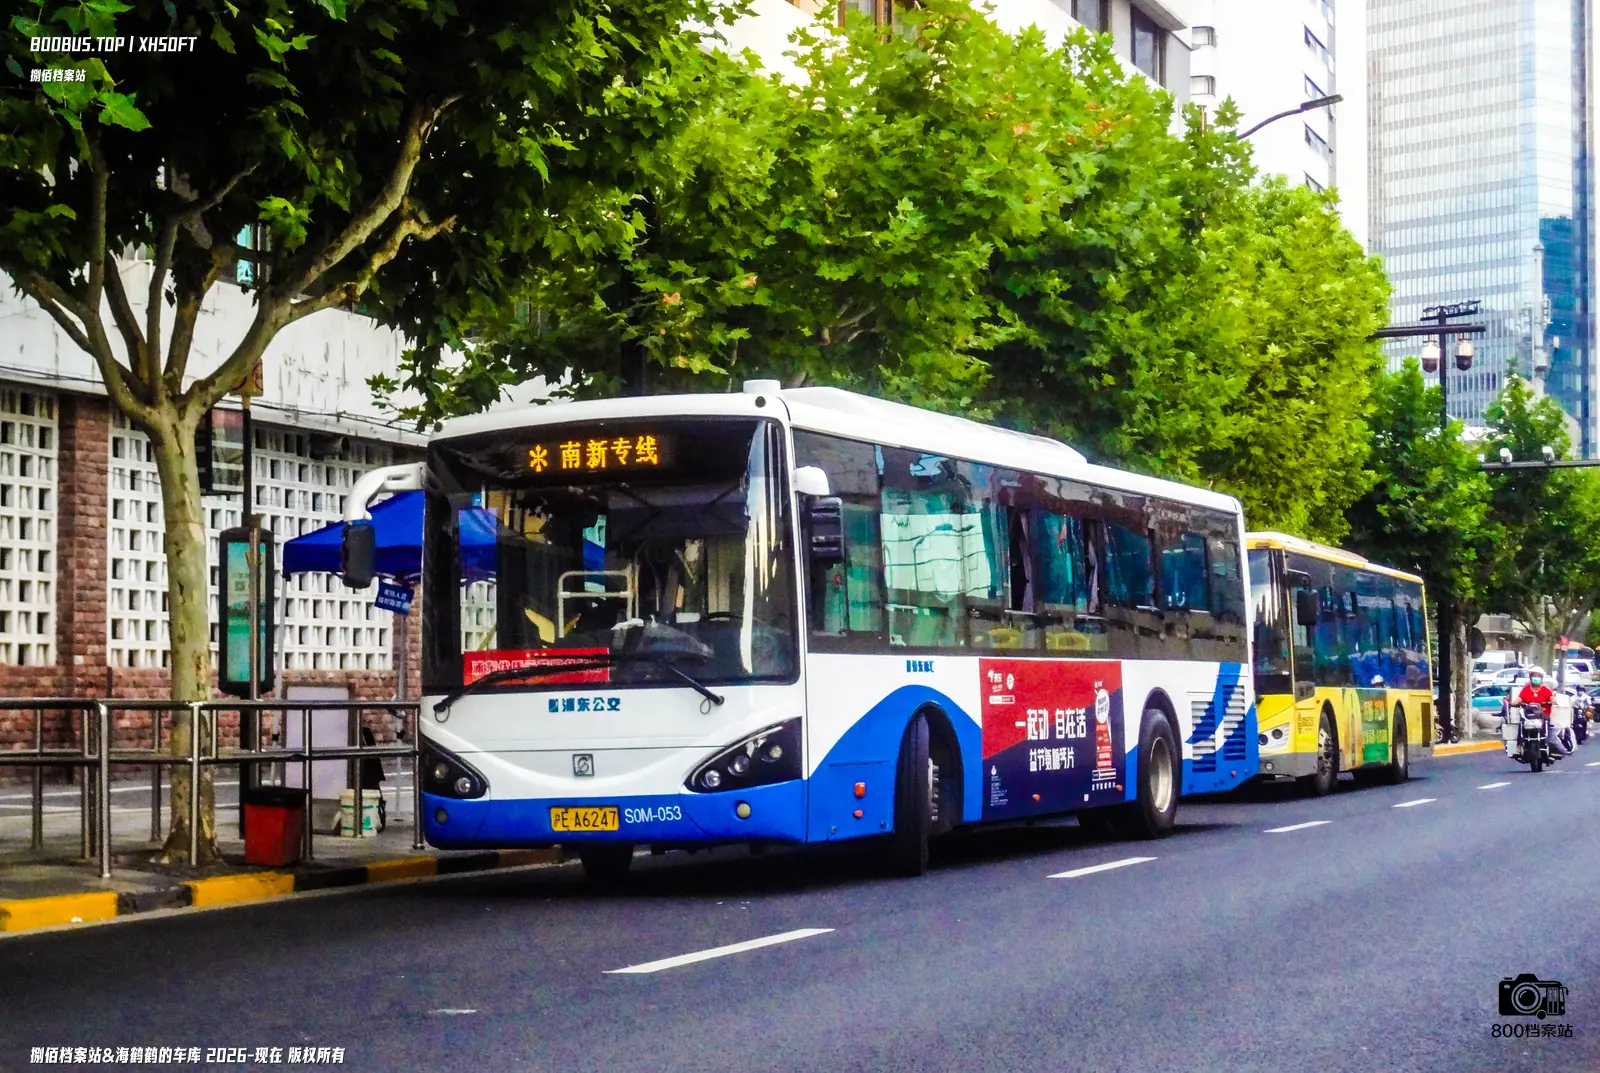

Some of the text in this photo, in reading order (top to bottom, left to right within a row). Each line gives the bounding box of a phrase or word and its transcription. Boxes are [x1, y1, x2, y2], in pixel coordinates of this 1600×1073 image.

[559, 435, 658, 470] 南新专线
[1015, 707, 1087, 741] 一起动 自在活
